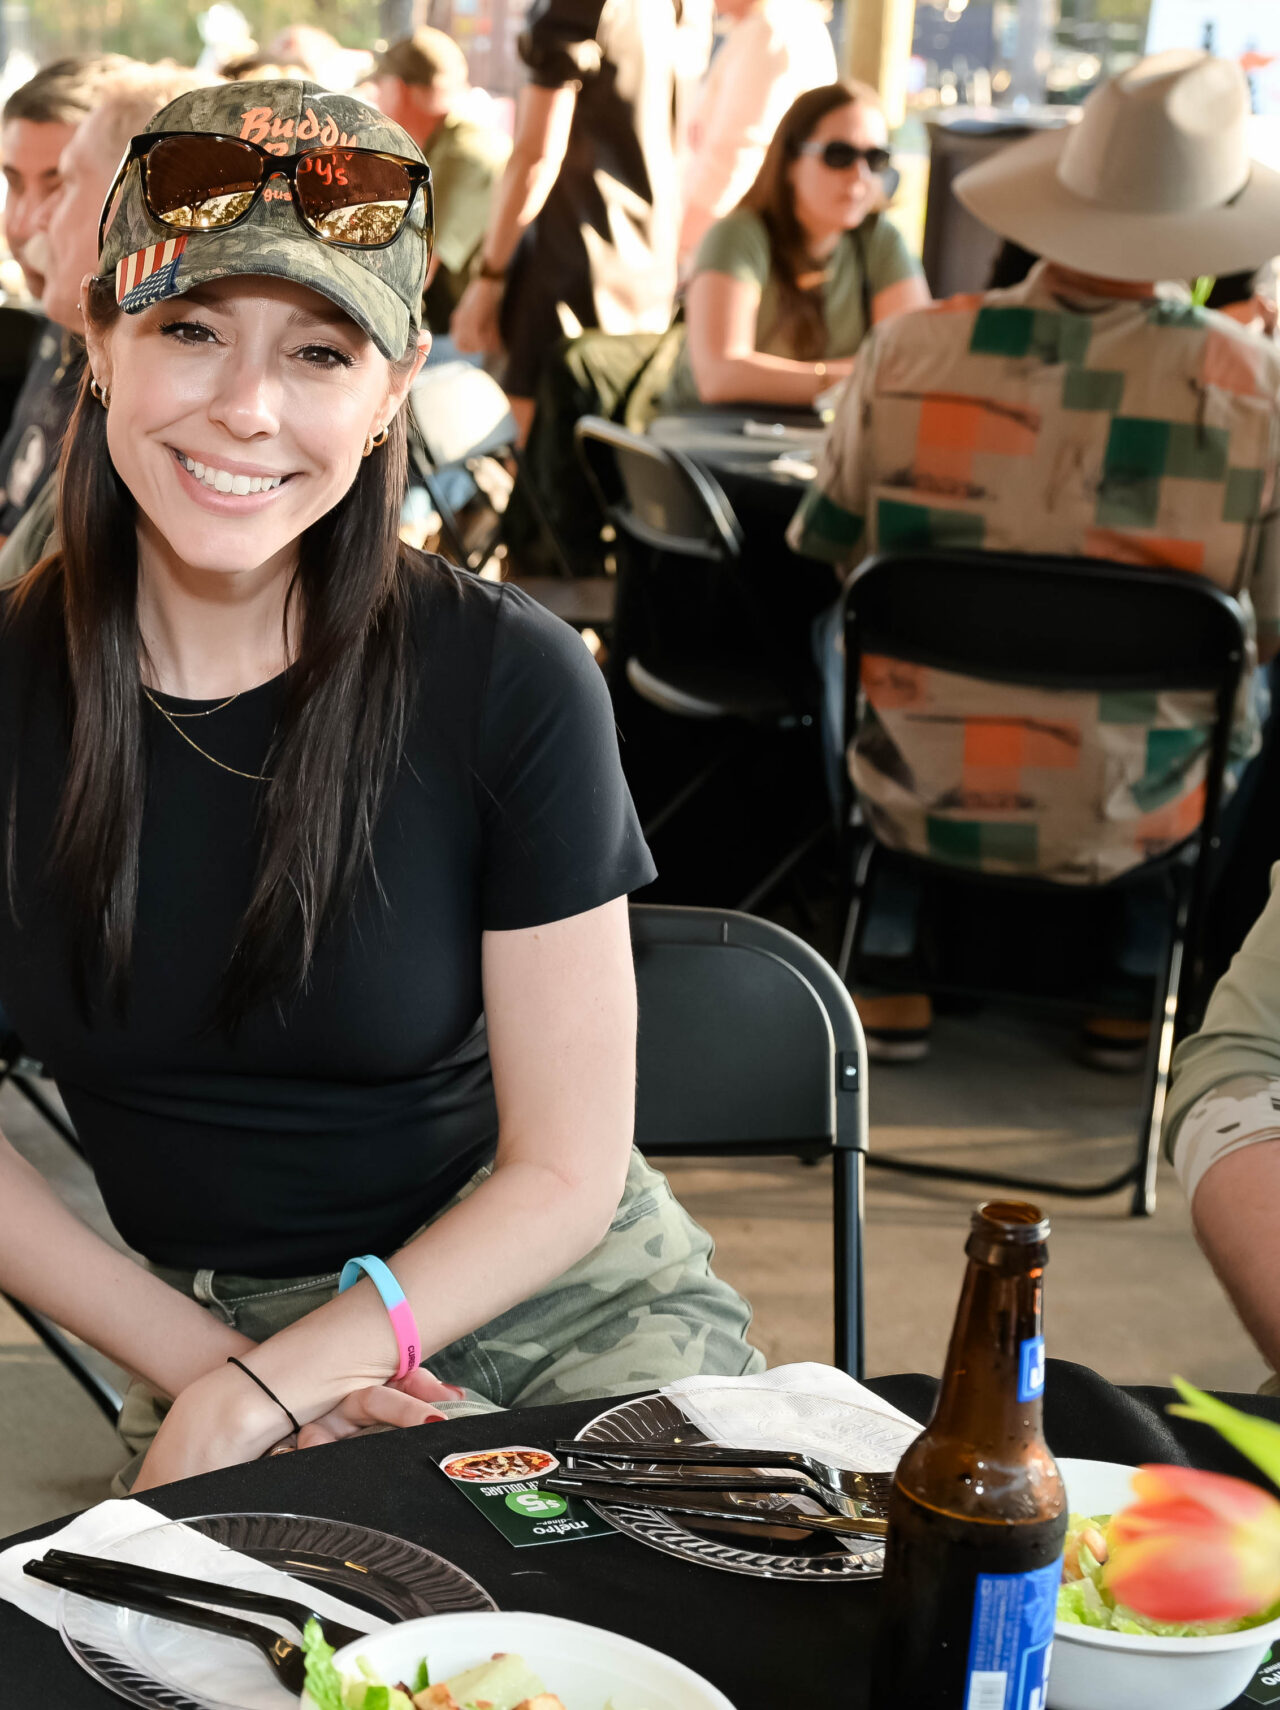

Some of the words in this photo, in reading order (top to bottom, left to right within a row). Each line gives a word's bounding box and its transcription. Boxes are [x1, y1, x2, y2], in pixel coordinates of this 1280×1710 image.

[239, 106, 358, 161] Buddy
[480, 1483, 528, 1497] DOLLARS
[516, 1493, 561, 1512] $5
[532, 1520, 589, 1536] metro
